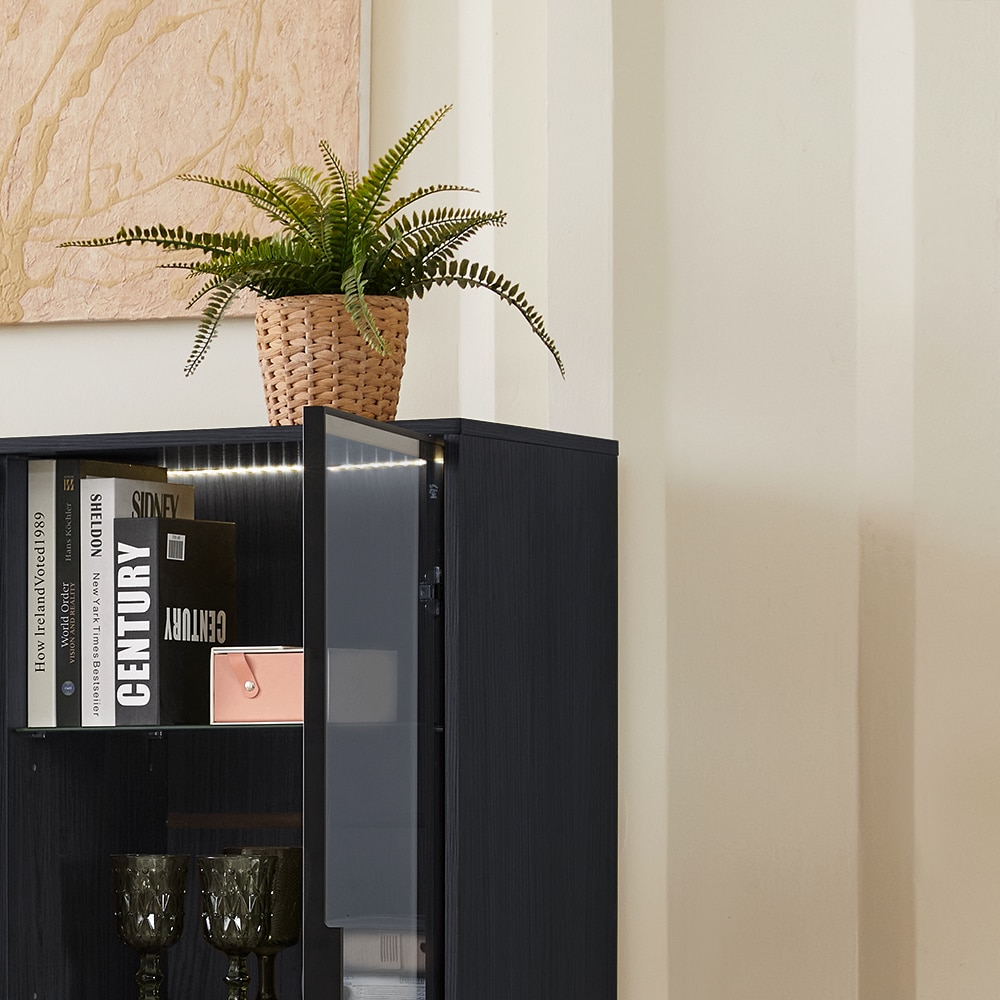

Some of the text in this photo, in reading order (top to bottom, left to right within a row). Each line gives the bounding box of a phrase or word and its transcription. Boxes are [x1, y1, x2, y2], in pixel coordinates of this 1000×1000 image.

[131, 490, 180, 518] SIDNEY
[90, 493, 103, 557] SHELDON
[92, 572, 101, 596] New
[60, 582, 70, 648] World Order
[116, 541, 151, 708] CENTURY
[164, 606, 227, 644] CENTURY
[34, 640, 46, 672] How
[92, 625, 101, 659] Times
